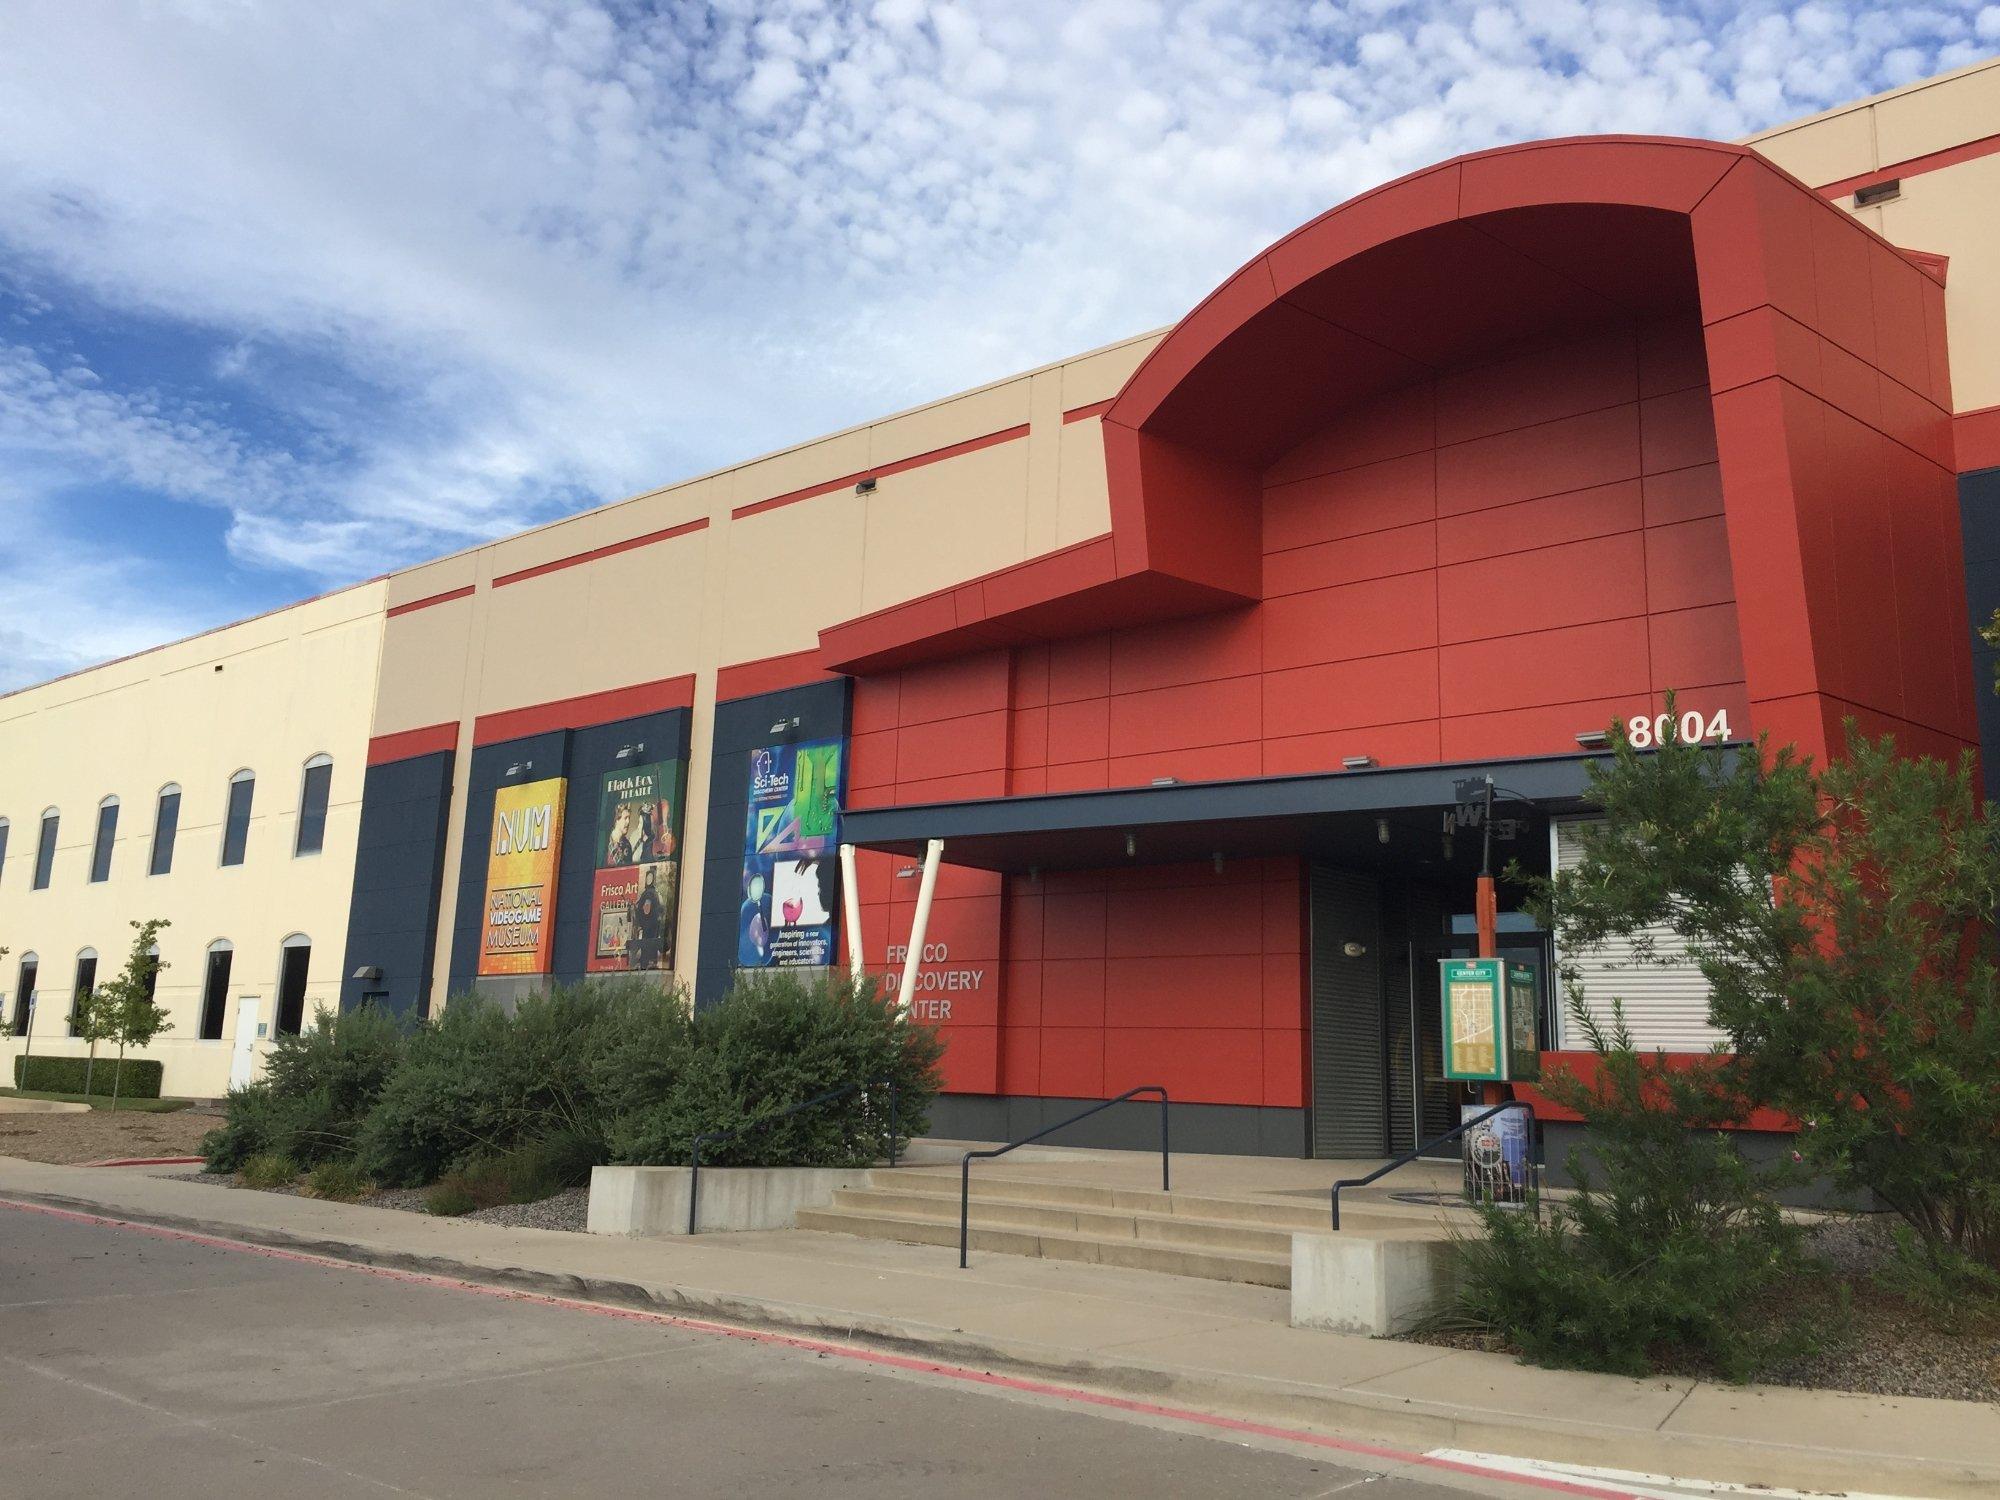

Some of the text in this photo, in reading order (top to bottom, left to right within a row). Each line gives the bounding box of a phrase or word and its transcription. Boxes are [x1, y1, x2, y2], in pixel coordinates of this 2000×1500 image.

[1628, 709, 1732, 748] 8004
[607, 775, 653, 793] Black Box
[753, 773, 789, 789] Sci-Tech
[601, 882, 639, 897] Frisco Art
[489, 889, 542, 911] NATIONAL
[599, 899, 629, 912] GALLERY
[489, 907, 542, 927] VIDEOGAME
[486, 926, 539, 949] MUSEUM
[779, 930, 805, 940] Inspiring
[887, 942, 948, 964] FRCO
[885, 970, 983, 992] DICOVERY
